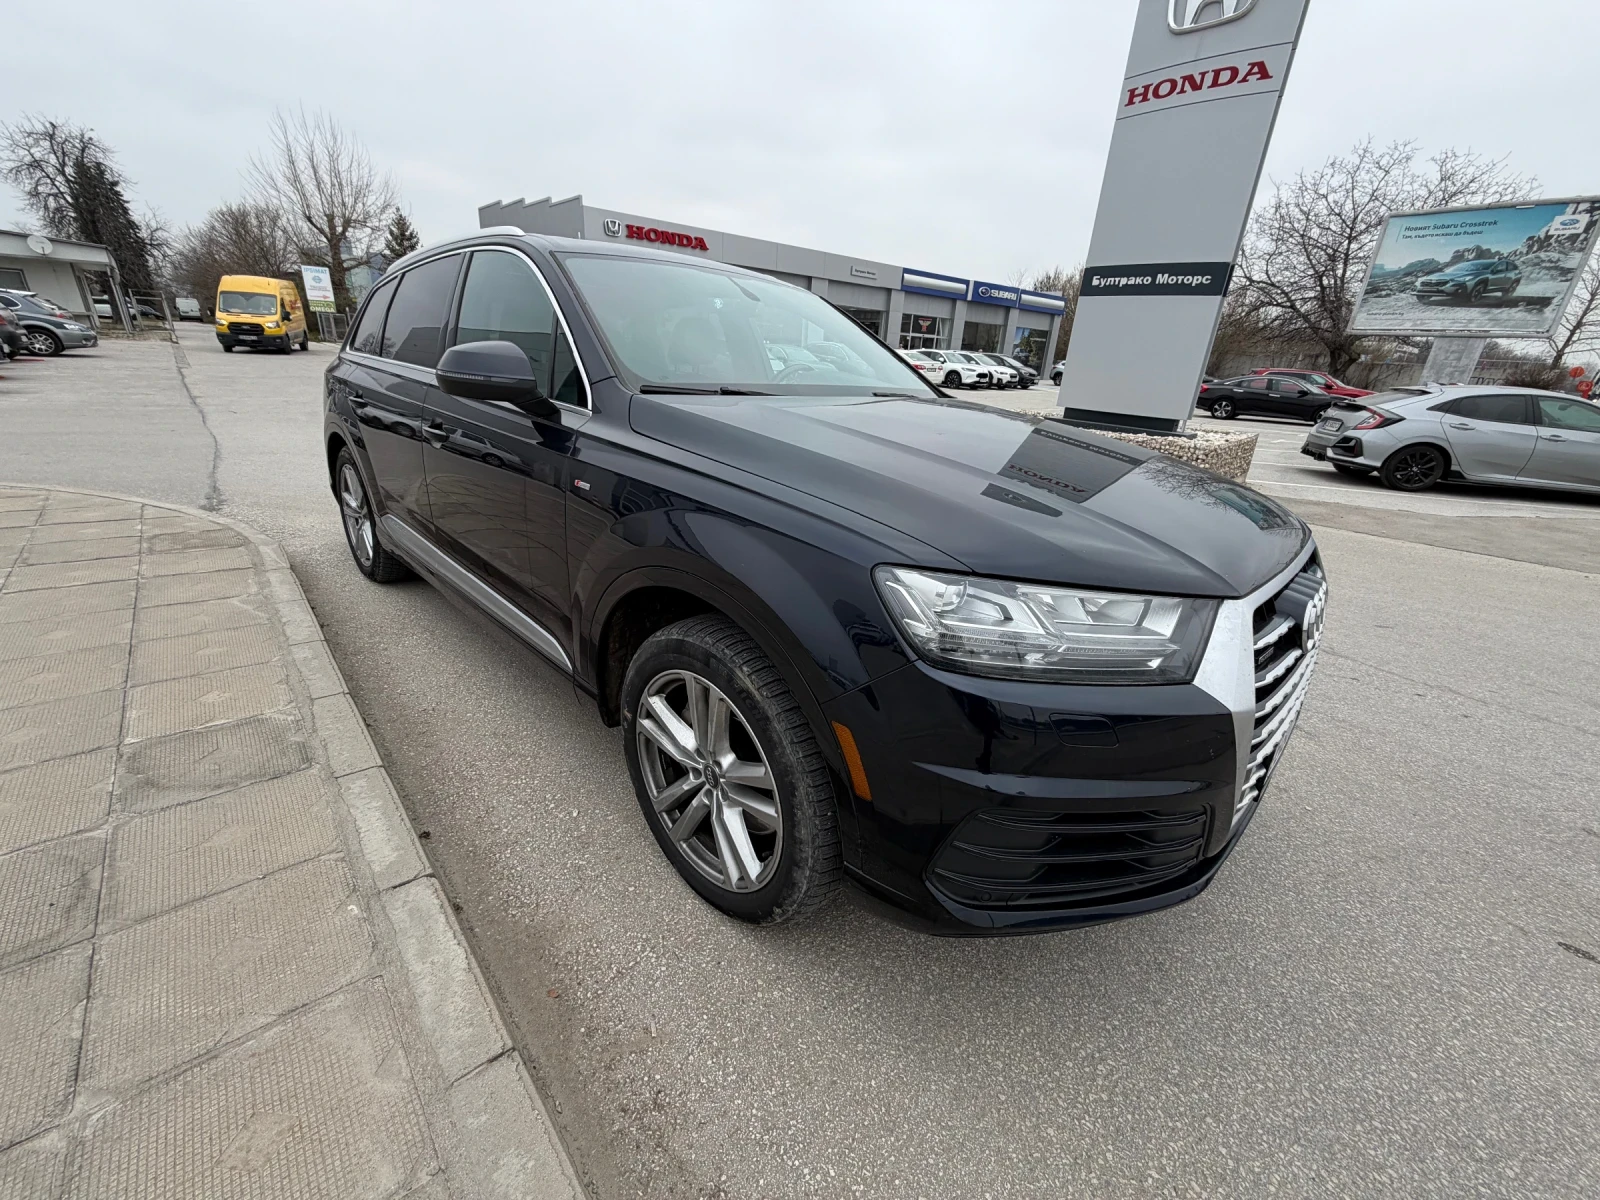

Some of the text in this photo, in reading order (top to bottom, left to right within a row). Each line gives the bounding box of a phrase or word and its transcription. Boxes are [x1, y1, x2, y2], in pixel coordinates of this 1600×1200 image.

[1124, 60, 1273, 107] HONDA
[1460, 220, 1499, 228] Crosstrek
[625, 224, 709, 250] HONDA
[1091, 273, 1212, 287] Бултрако Моторс
[990, 289, 1018, 301] SUBARU
